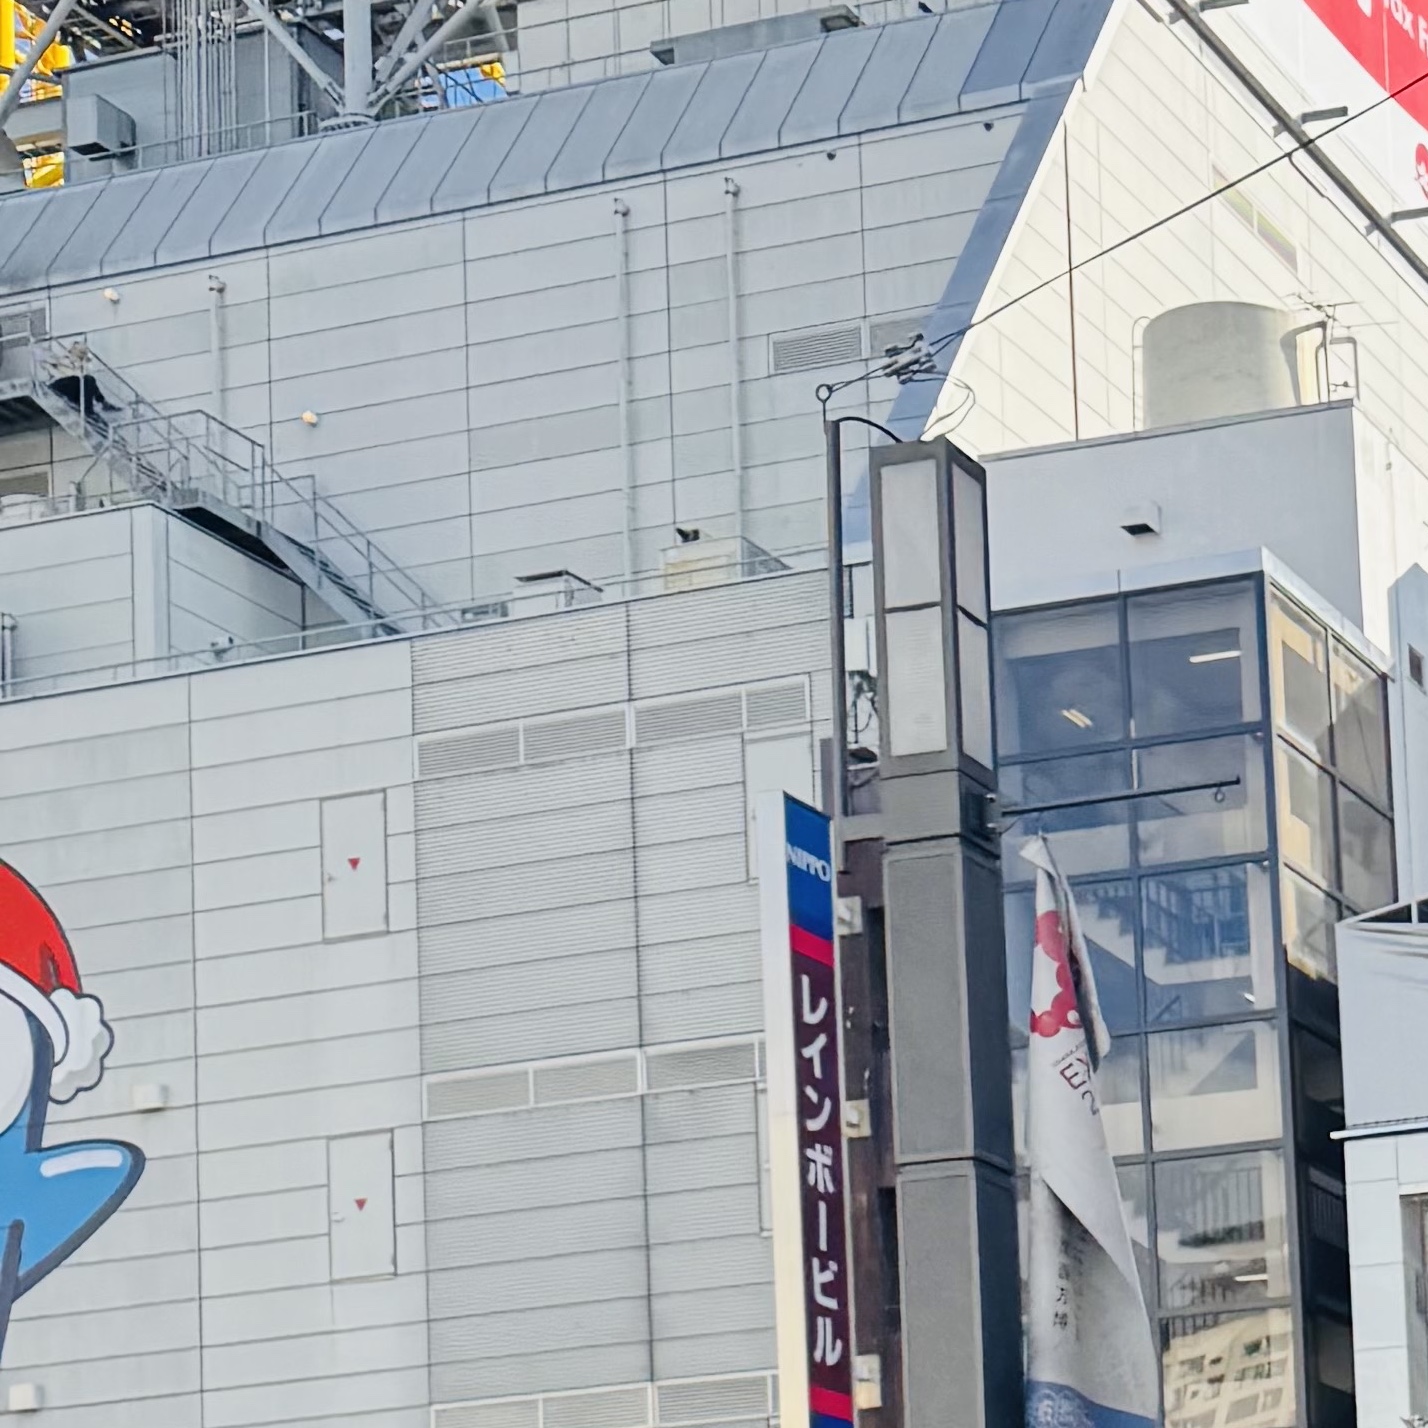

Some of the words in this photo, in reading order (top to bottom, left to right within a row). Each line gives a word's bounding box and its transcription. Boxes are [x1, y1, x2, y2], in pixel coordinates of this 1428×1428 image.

[784, 843, 832, 884] NIPPO
[800, 973, 844, 1369] レインボービル
